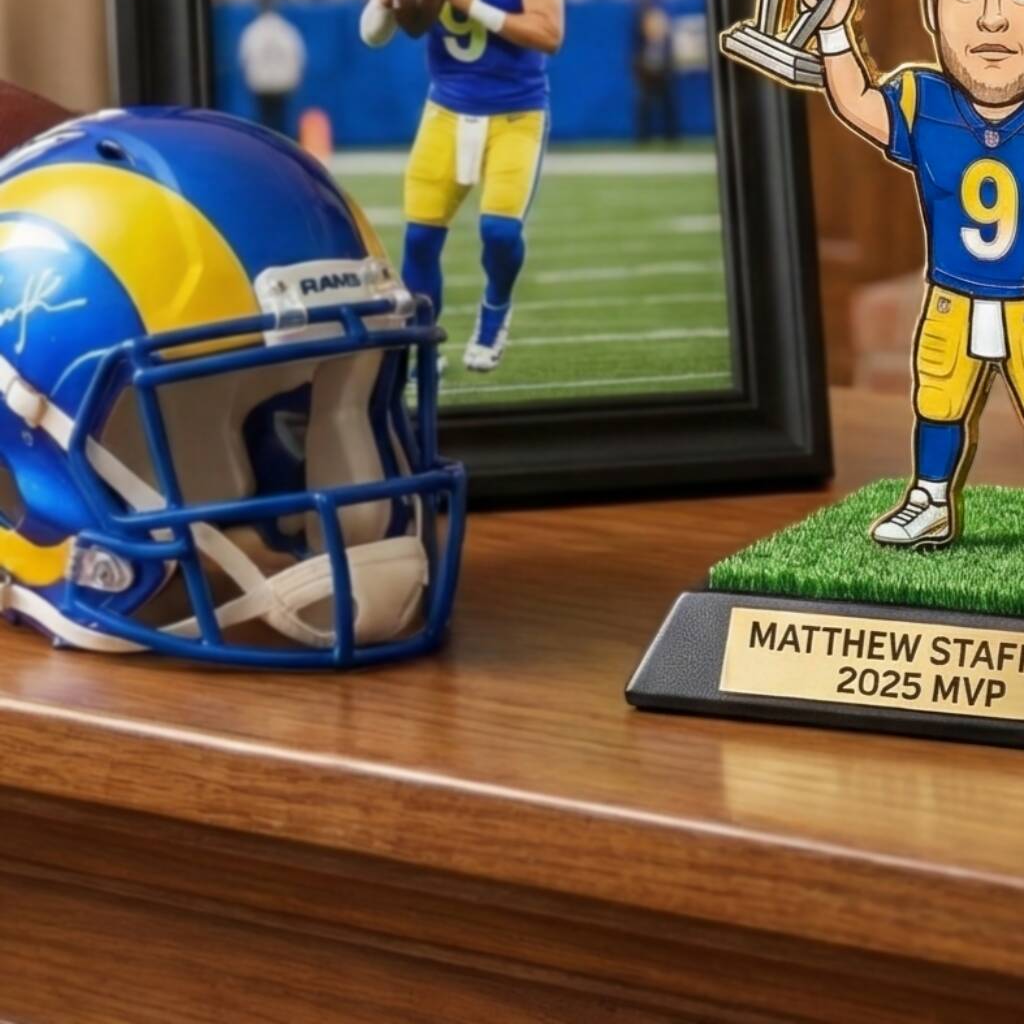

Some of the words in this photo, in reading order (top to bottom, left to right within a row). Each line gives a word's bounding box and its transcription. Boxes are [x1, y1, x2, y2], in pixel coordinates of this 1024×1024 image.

[961, 158, 1019, 262] 9
[748, 621, 922, 664] MATTHEW
[836, 667, 922, 701] 2025
[932, 675, 1008, 708] MVP
